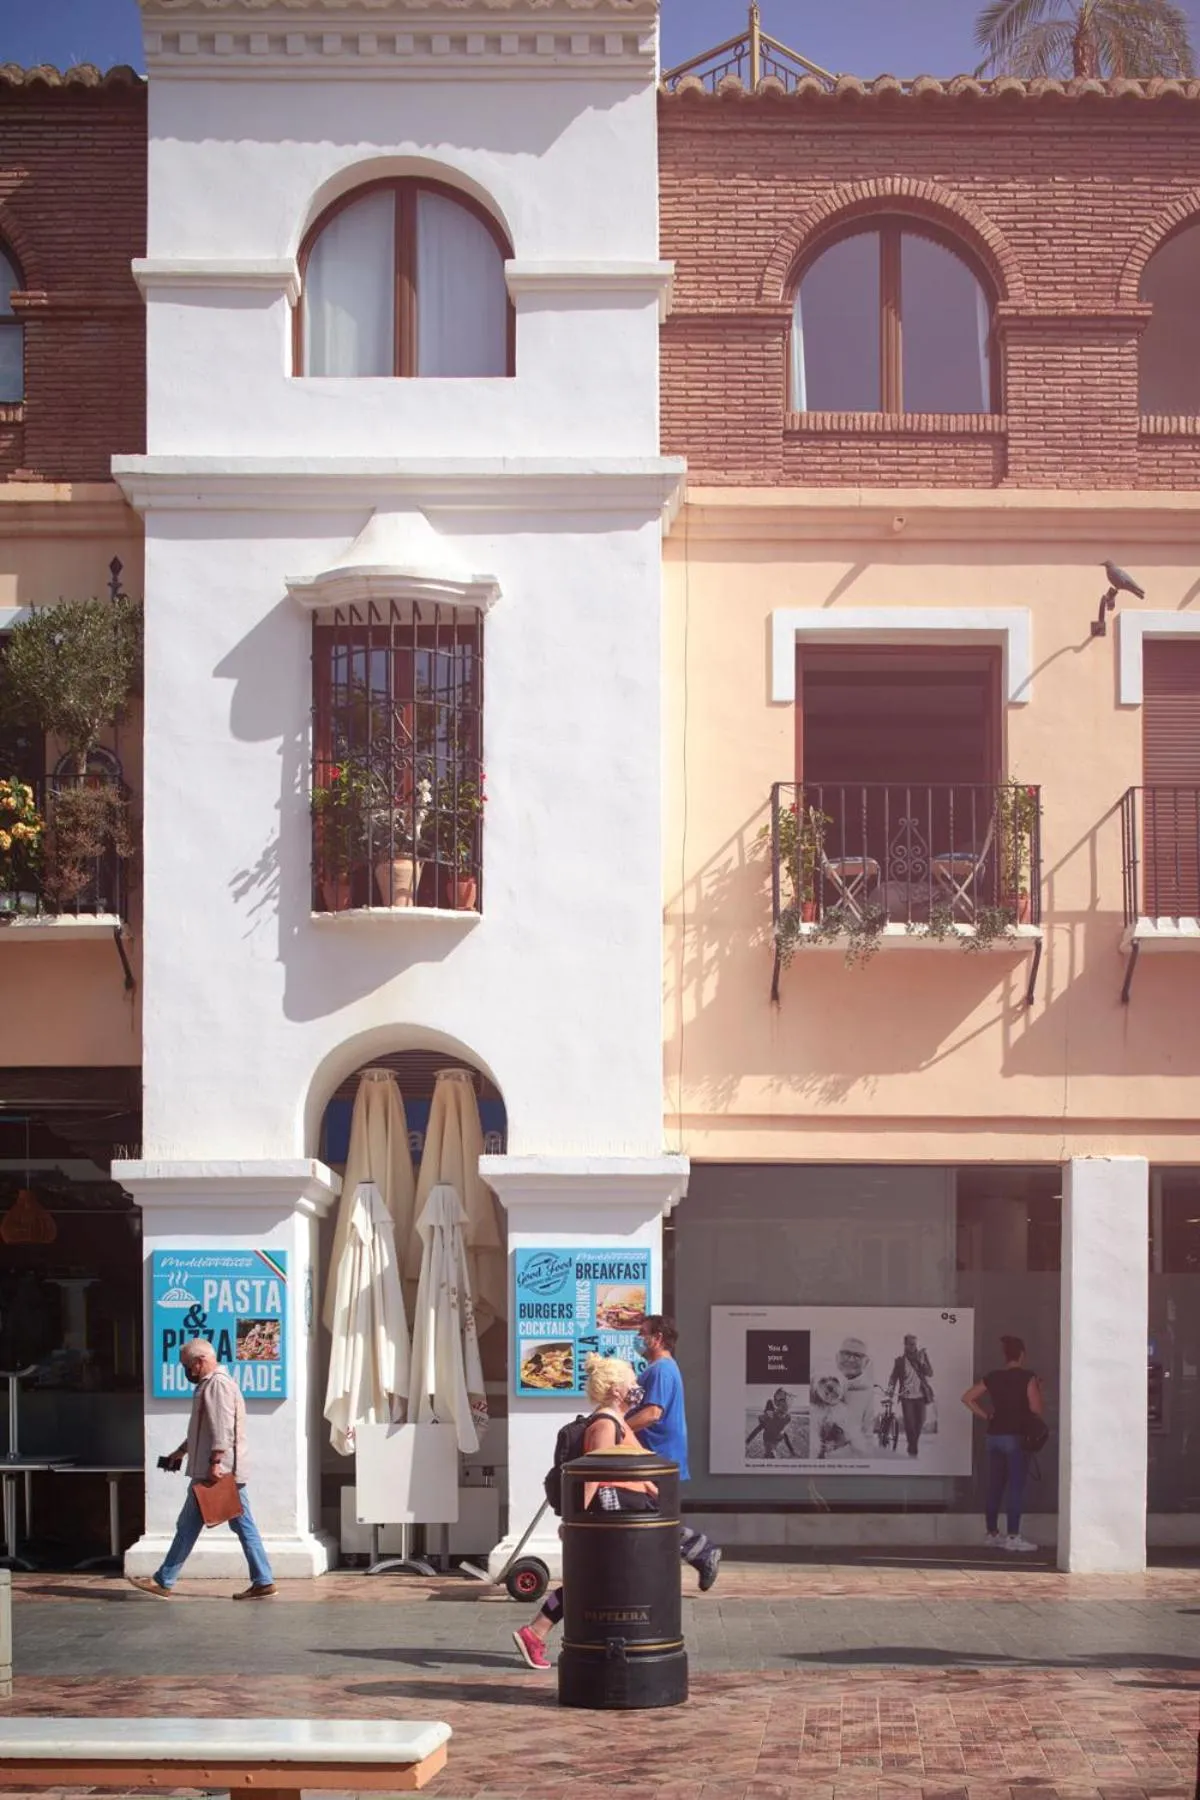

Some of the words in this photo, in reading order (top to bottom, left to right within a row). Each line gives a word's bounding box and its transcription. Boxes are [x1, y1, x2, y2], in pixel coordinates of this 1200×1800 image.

[517, 1266, 541, 1286] Good
[546, 1257, 572, 1276] Food
[576, 1263, 647, 1279] BREAKFAST
[203, 1279, 282, 1313] PASTA
[575, 1279, 590, 1318] DRINKS
[183, 1303, 207, 1329] &
[519, 1302, 573, 1319] BURGERS
[519, 1321, 574, 1335] COCKTAILS
[584, 1611, 648, 1621] PAPELERA
